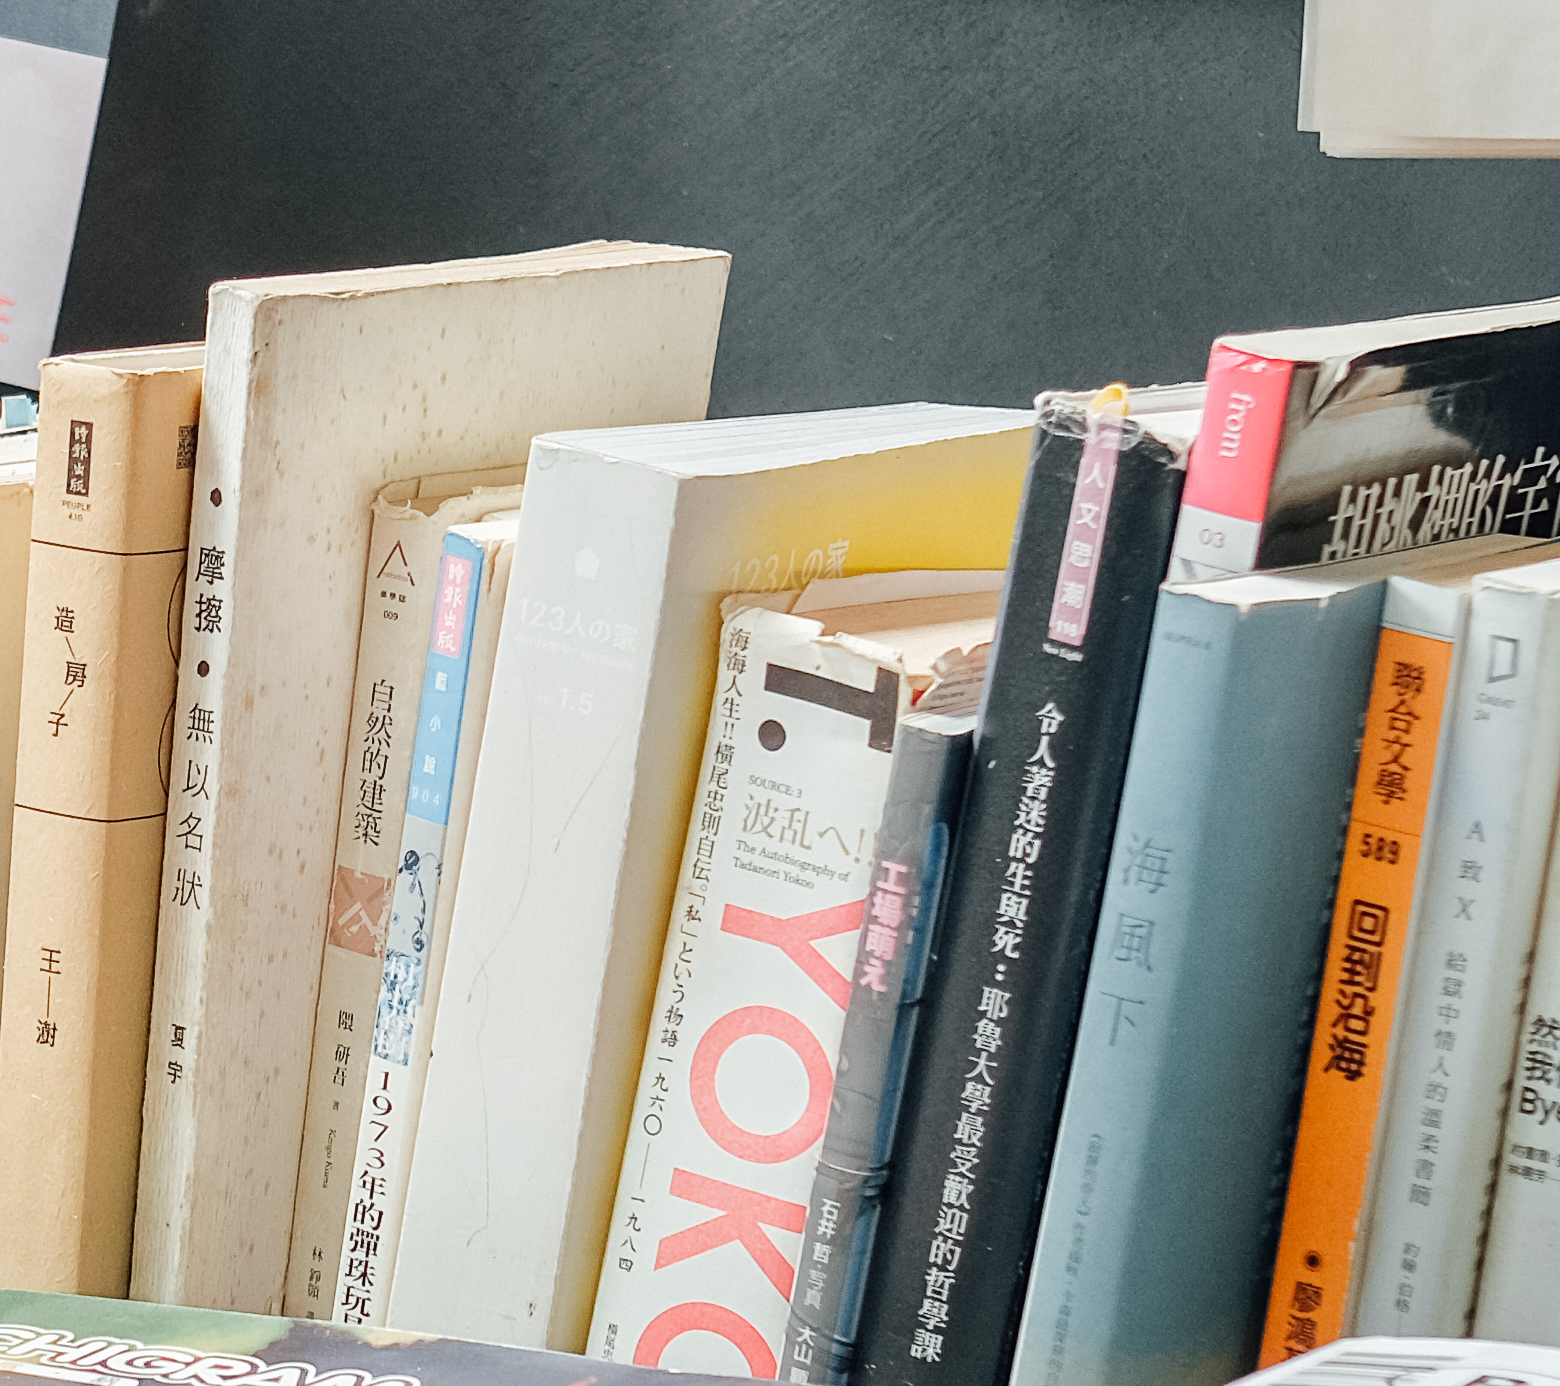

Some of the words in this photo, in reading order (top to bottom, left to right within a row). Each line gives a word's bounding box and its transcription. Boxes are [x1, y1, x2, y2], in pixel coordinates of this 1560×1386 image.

[68, 425, 90, 494] 時報出版
[1218, 391, 1257, 459] from
[61, 499, 92, 512] PEOPLE
[1060, 457, 1108, 610] 人文思潮
[1198, 527, 1226, 550] 03
[194, 545, 226, 635] 摩擦
[435, 562, 468, 654] 時報出版
[46, 604, 89, 738] 造房子
[353, 678, 396, 848] 自然的建築
[1370, 660, 1427, 805] 聯合文學
[171, 702, 217, 911] 無以名狀
[732, 855, 781, 882] Tadanori
[782, 869, 815, 890] Yokoo
[736, 838, 759, 858] The
[760, 843, 837, 882] Autobiography
[1453, 819, 1487, 921] A致X
[858, 859, 909, 994] 工場萌え
[1098, 831, 1175, 1047] 海風下
[35, 946, 63, 1048] 王澍
[1322, 898, 1390, 1083] 回到沿海
[166, 1023, 188, 1085] 夏宇
[331, 1009, 356, 1087] 隈研吾
